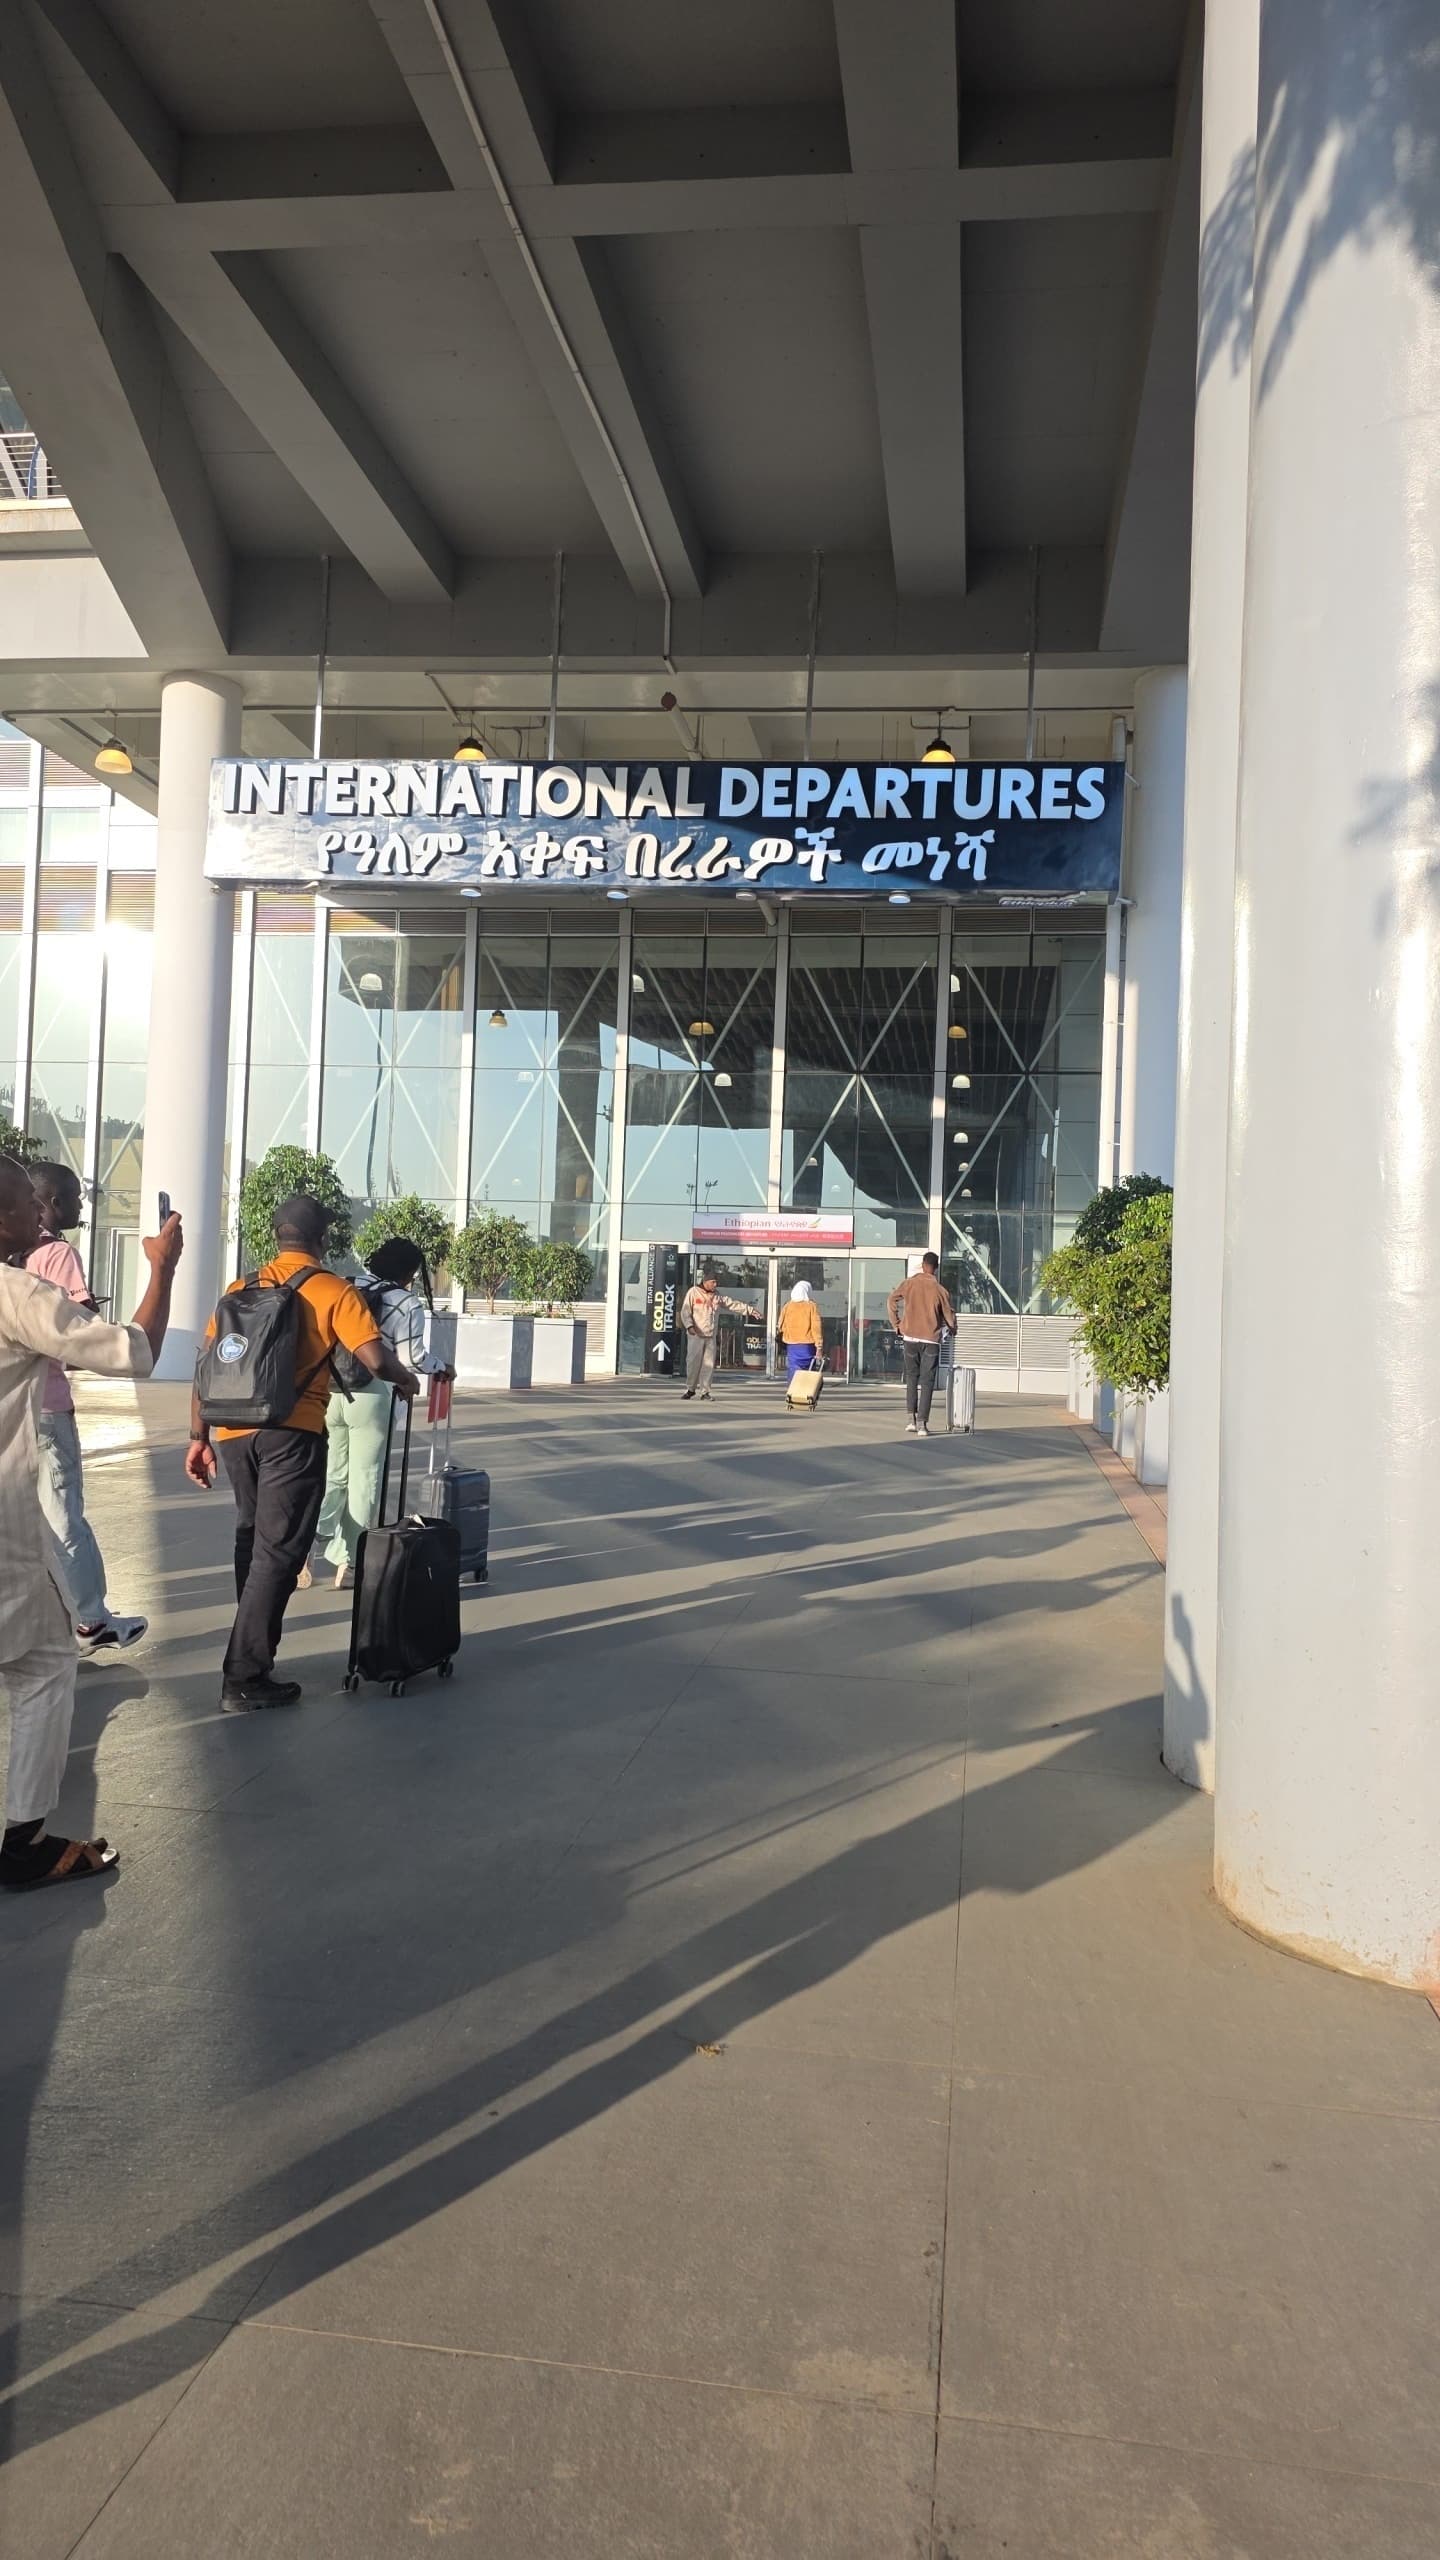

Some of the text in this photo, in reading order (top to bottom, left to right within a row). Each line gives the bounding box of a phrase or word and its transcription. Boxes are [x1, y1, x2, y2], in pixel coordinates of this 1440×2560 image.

[223, 763, 1107, 821] INTERNATIONAL DEPARTURES
[316, 826, 996, 882] የዓለም አቀፍ በረራዎች መነሻ
[653, 1290, 665, 1331] GOLD
[664, 1283, 675, 1330] TRACK
